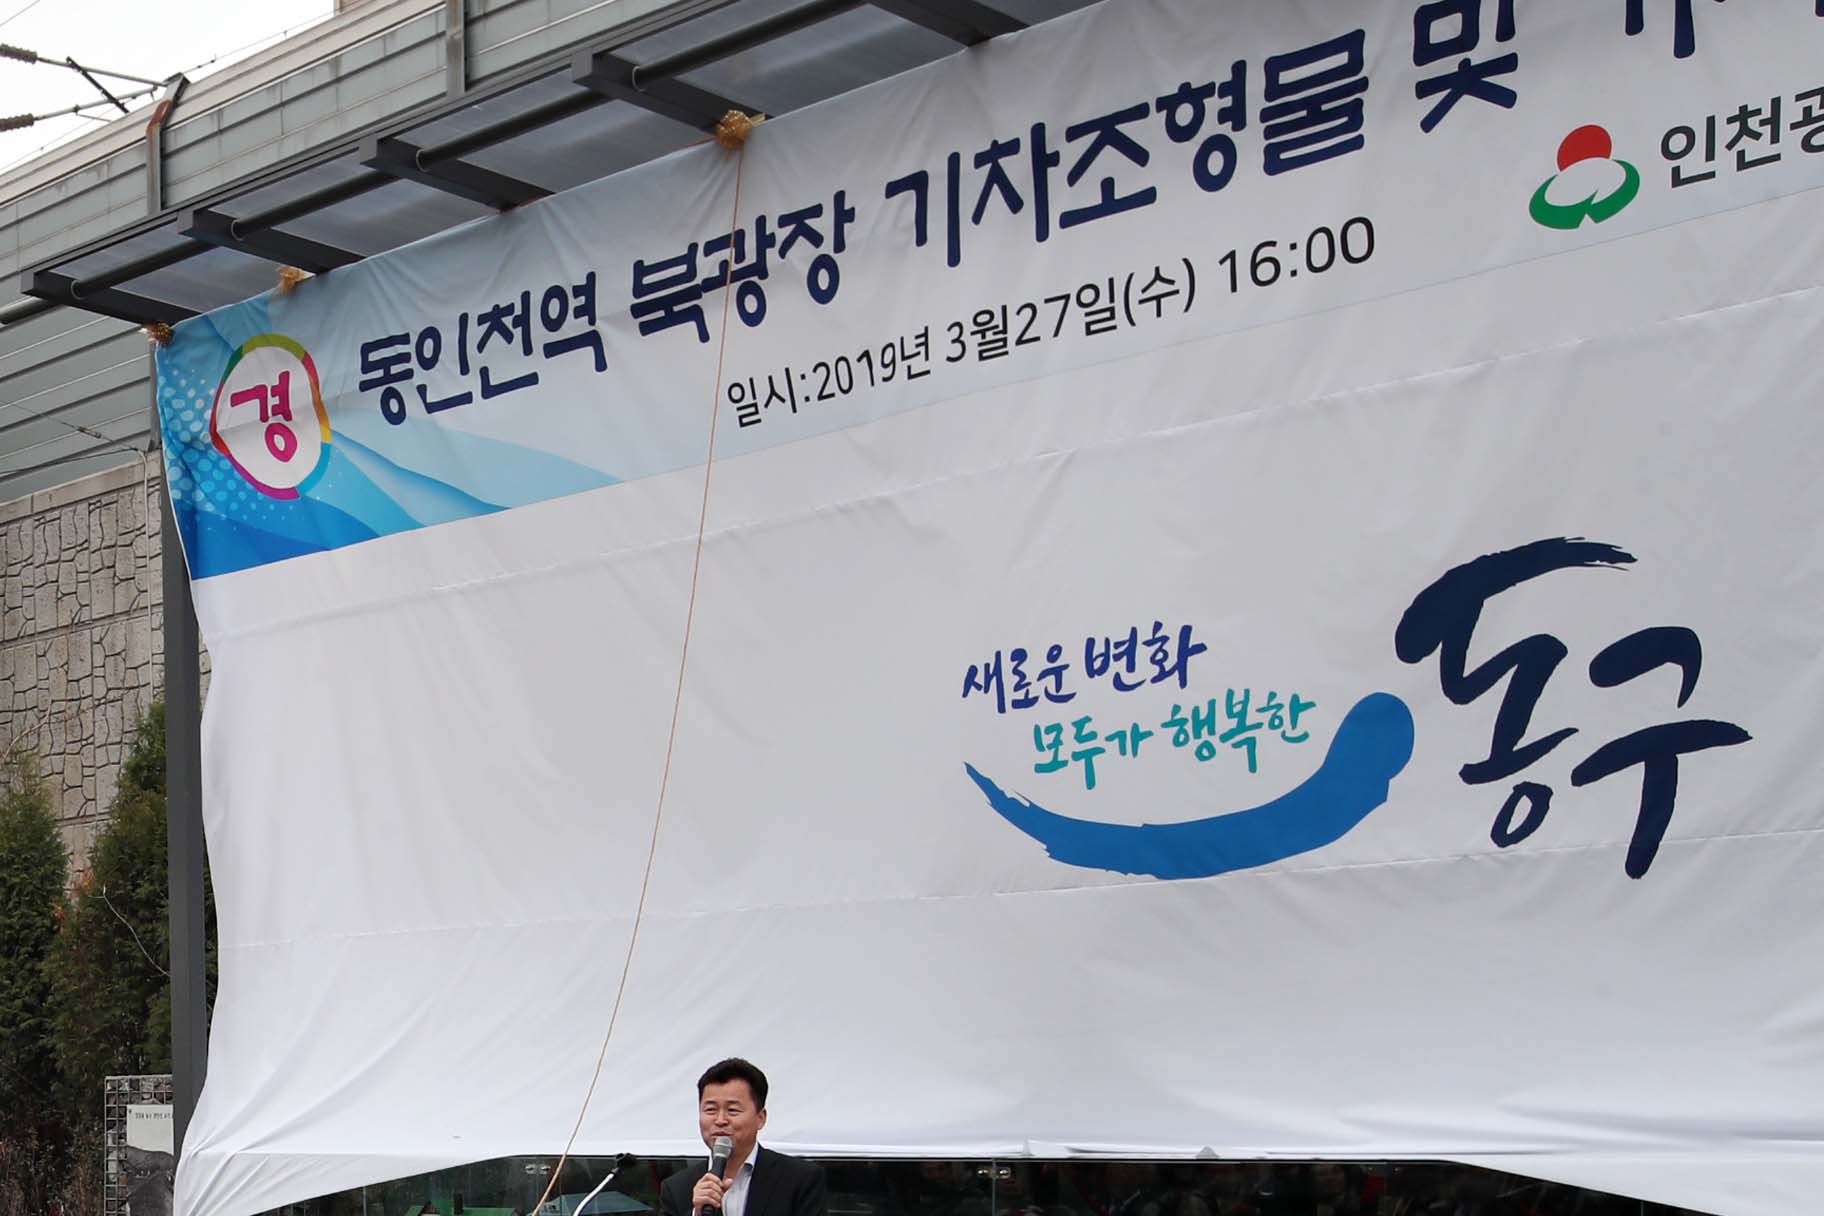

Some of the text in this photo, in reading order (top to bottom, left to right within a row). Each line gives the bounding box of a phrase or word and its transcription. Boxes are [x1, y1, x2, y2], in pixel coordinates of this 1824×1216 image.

[358, 0, 1519, 426] 동인천역 북광장 기차조형물 및
[727, 215, 1376, 428] 일시:2019년 3월27일(수) 16:00
[229, 369, 298, 463] 경
[962, 620, 1208, 714] 새로운 변화
[1033, 687, 1317, 791] 모두가 행복한
[1394, 535, 1754, 880] 동구
